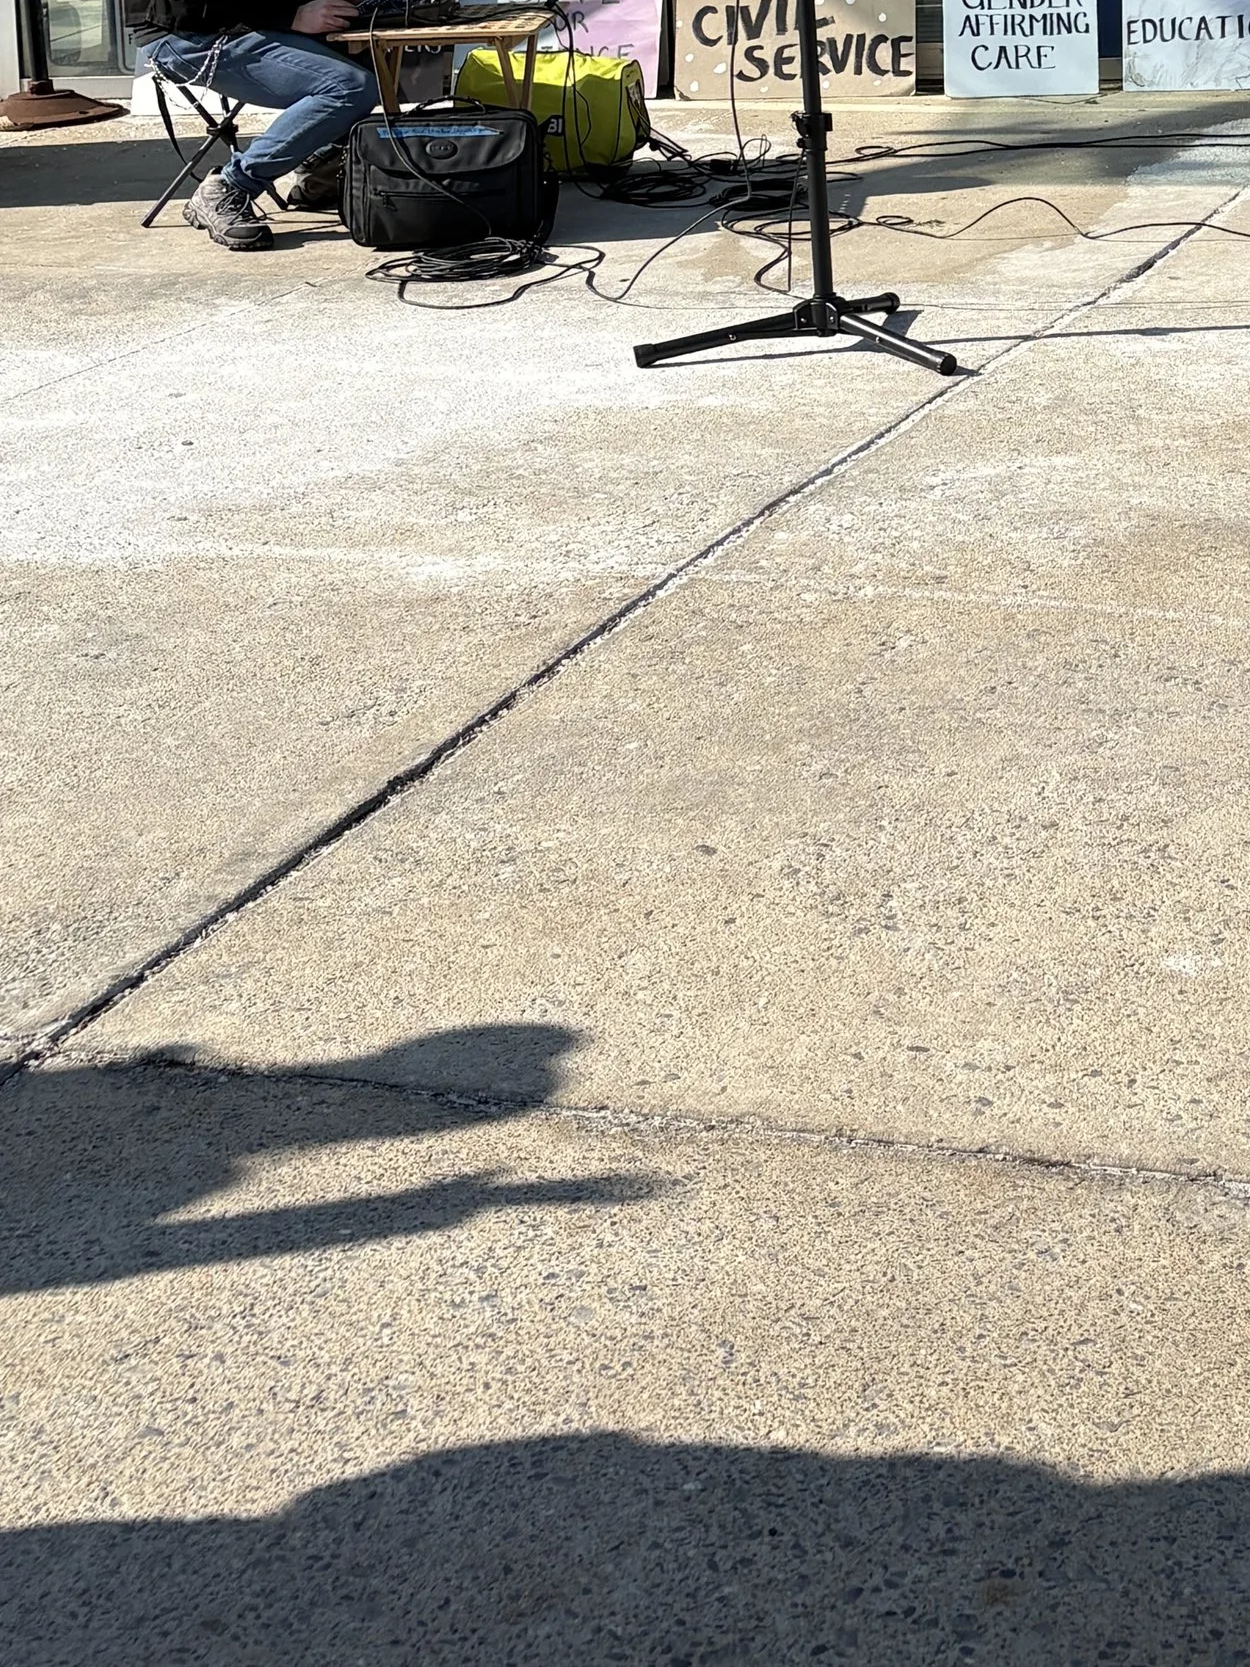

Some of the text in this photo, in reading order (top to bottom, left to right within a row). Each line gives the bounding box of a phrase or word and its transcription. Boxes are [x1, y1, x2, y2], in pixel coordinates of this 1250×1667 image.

[544, 11, 589, 33] UR
[958, 11, 1090, 37] AFFIRMING
[734, 32, 915, 82] SERVICE
[971, 44, 1057, 71] CARE
